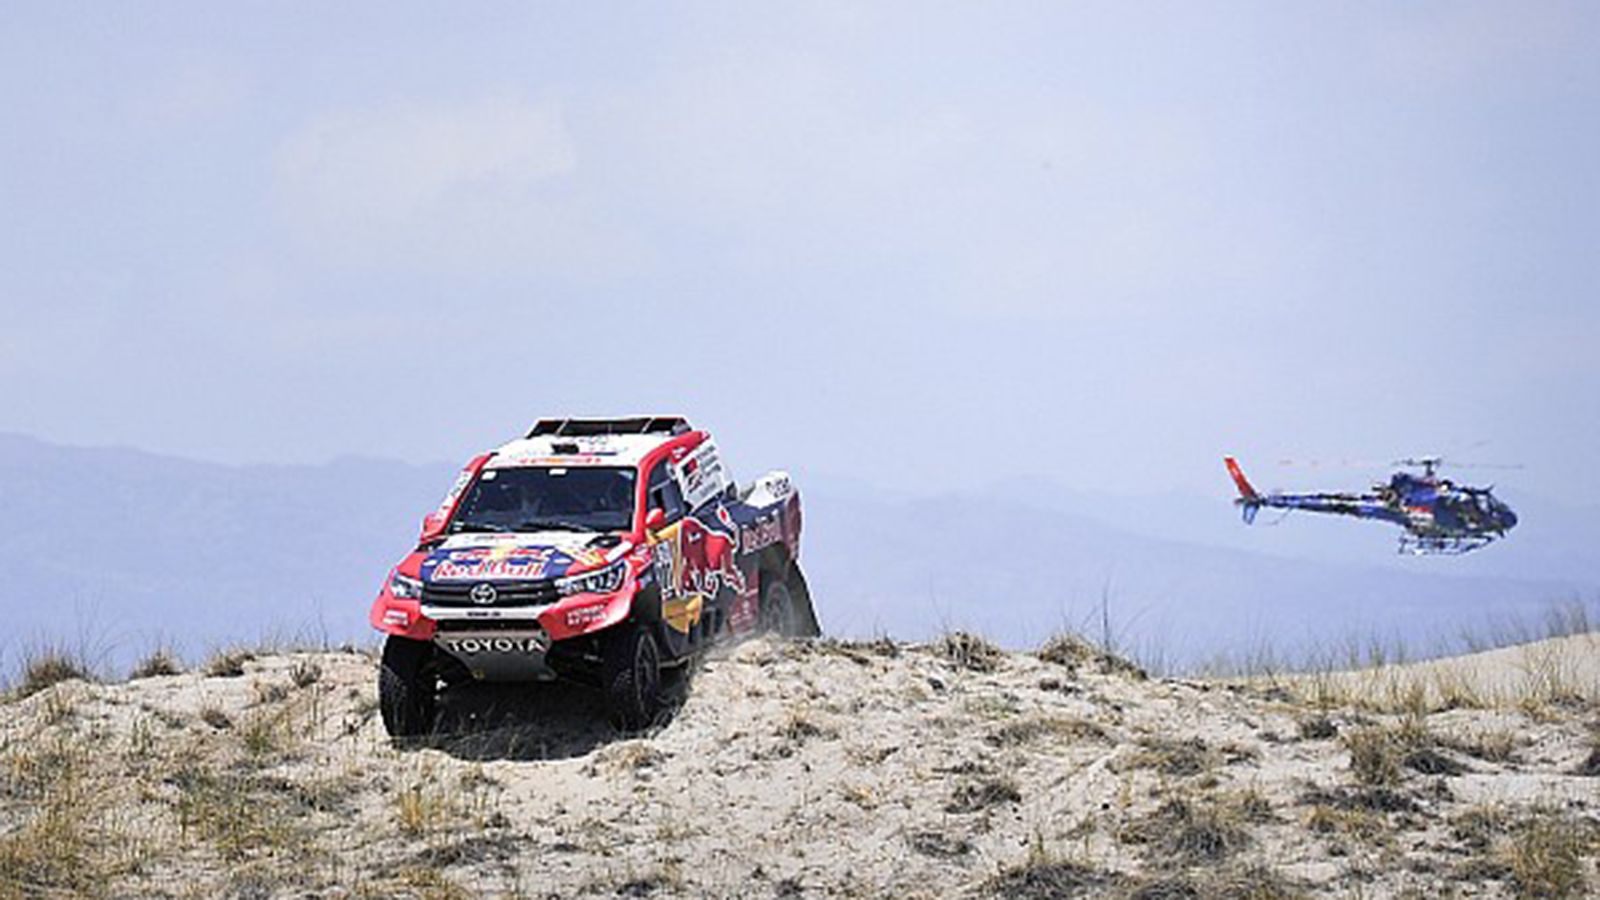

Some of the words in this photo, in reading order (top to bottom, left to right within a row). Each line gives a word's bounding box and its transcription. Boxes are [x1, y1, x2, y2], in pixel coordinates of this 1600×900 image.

[431, 559, 487, 582] Red
[486, 559, 546, 580] Bull
[449, 638, 547, 653] TOYOTA
